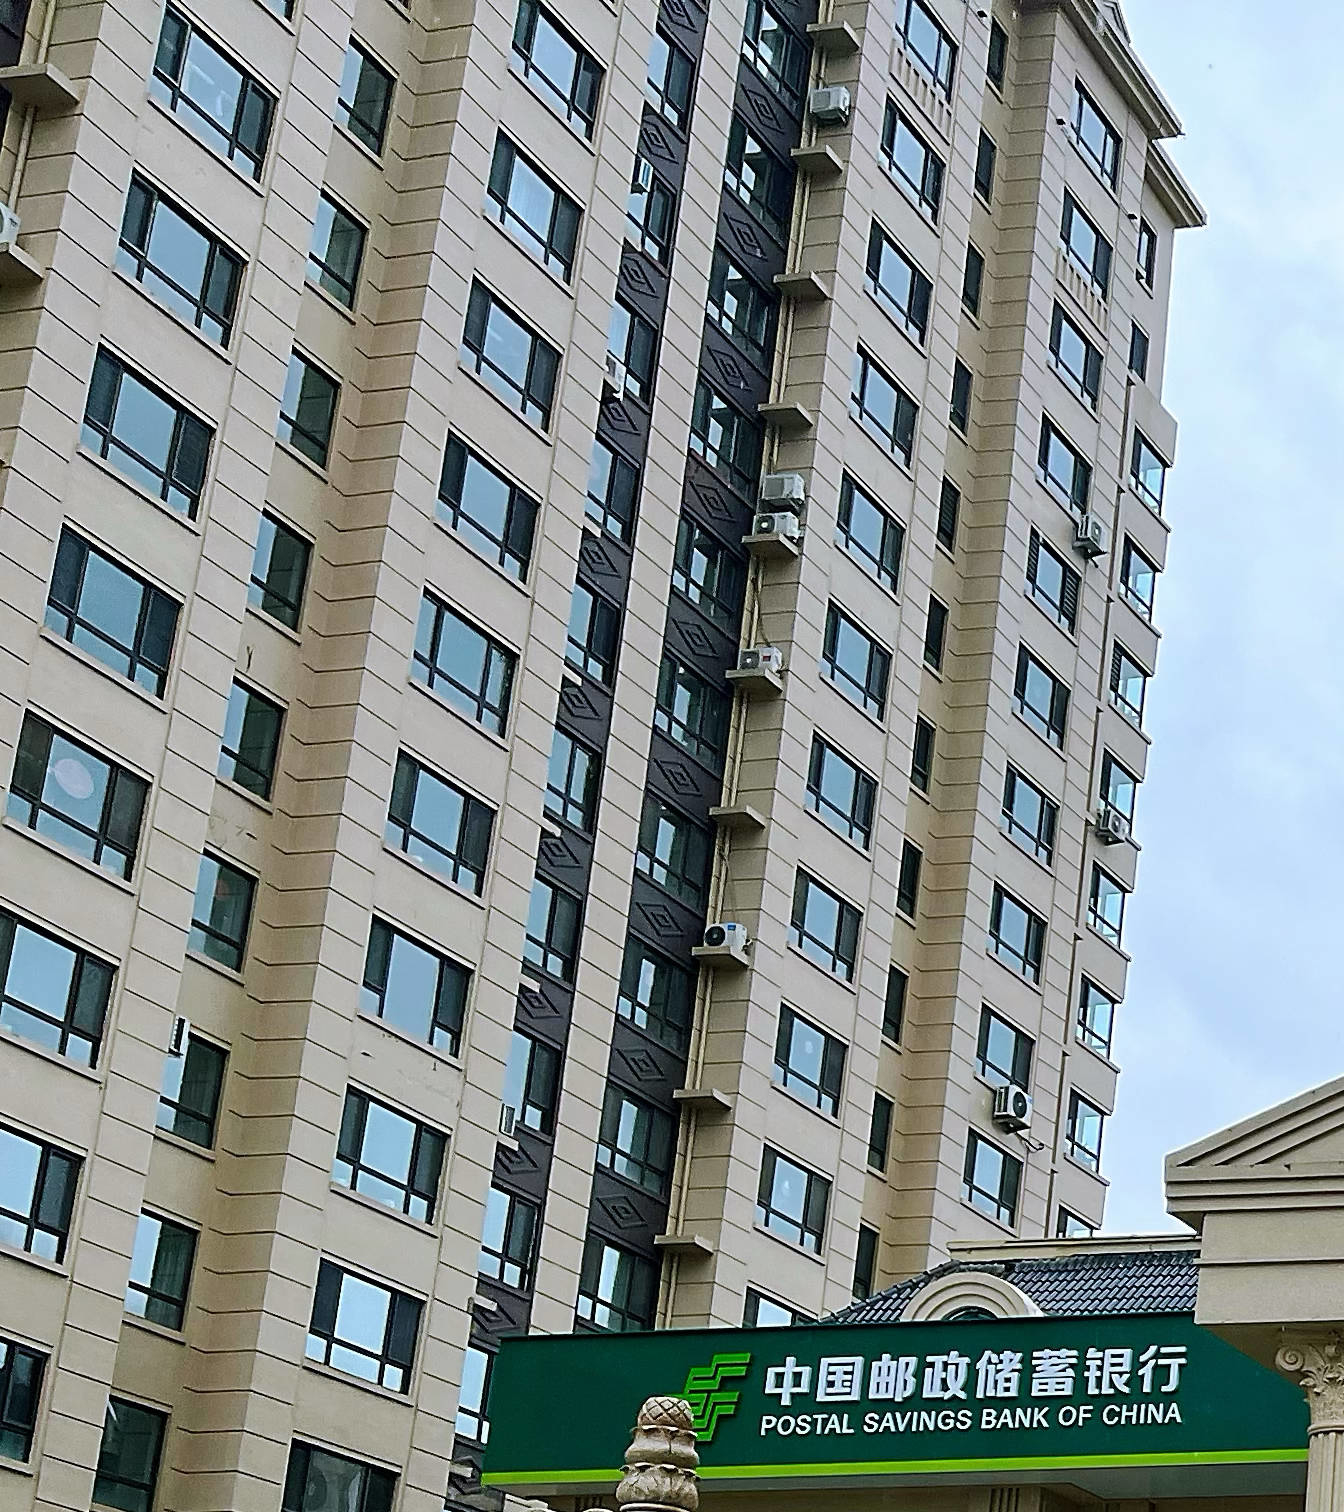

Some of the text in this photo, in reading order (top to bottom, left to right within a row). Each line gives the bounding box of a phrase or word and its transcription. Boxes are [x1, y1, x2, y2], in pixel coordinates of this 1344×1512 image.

[763, 1344, 1189, 1407] 中国邮政储蓄银行
[759, 1401, 1183, 1437] POSTAL SAVINGS BANK OF CHINA
